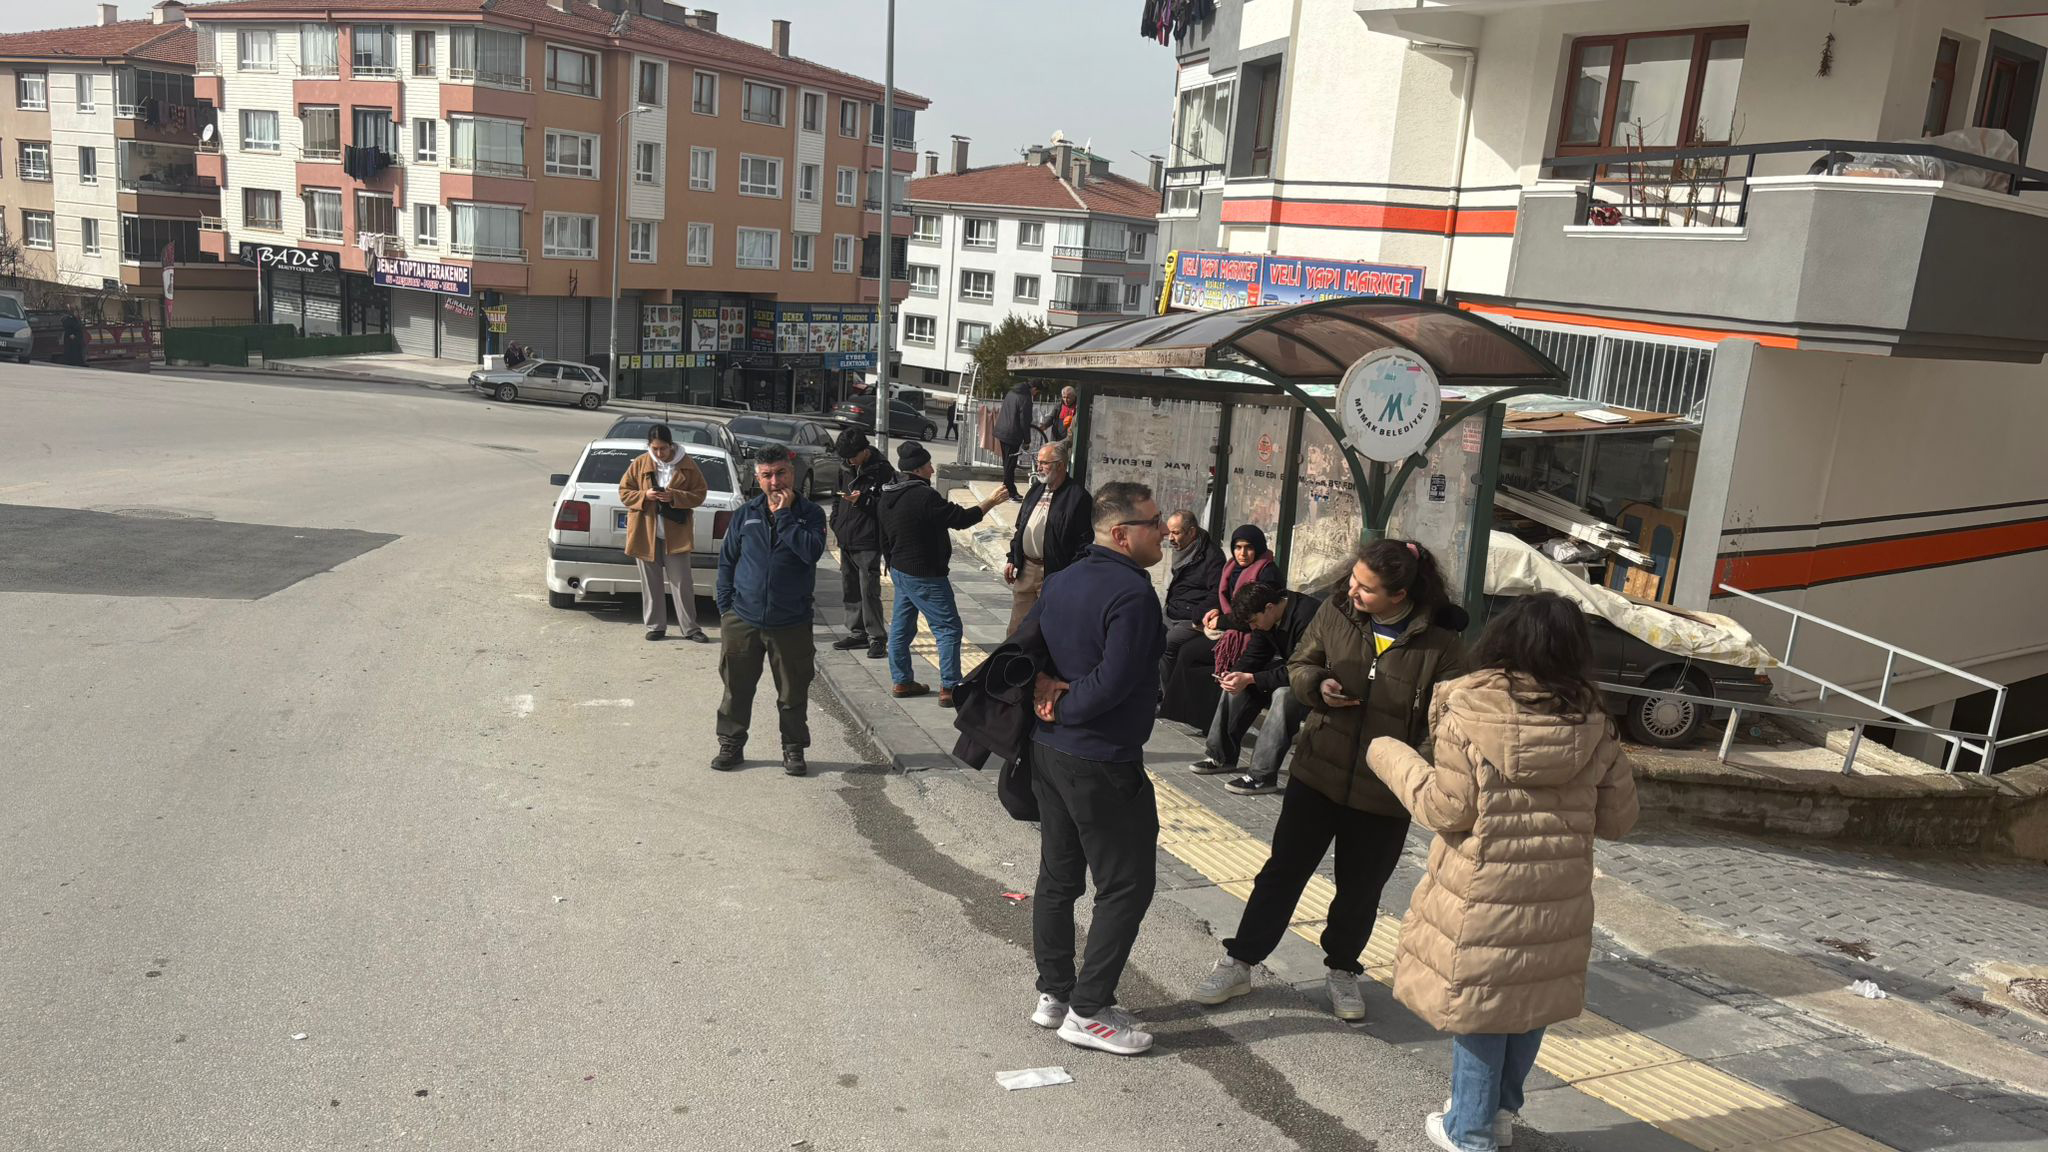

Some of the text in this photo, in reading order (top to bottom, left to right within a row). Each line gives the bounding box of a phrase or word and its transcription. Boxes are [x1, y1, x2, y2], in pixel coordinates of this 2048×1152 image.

[259, 246, 320, 267] BADE
[376, 258, 468, 283] DENEK TOPTAN PERAKENDE
[1200, 258, 1219, 278] YAPI
[1220, 260, 1258, 282] MARKET
[1270, 260, 1414, 297] VELİ YAPI MARKET
[692, 308, 717, 318] DENEK
[1354, 397, 1378, 433] MAMAK
